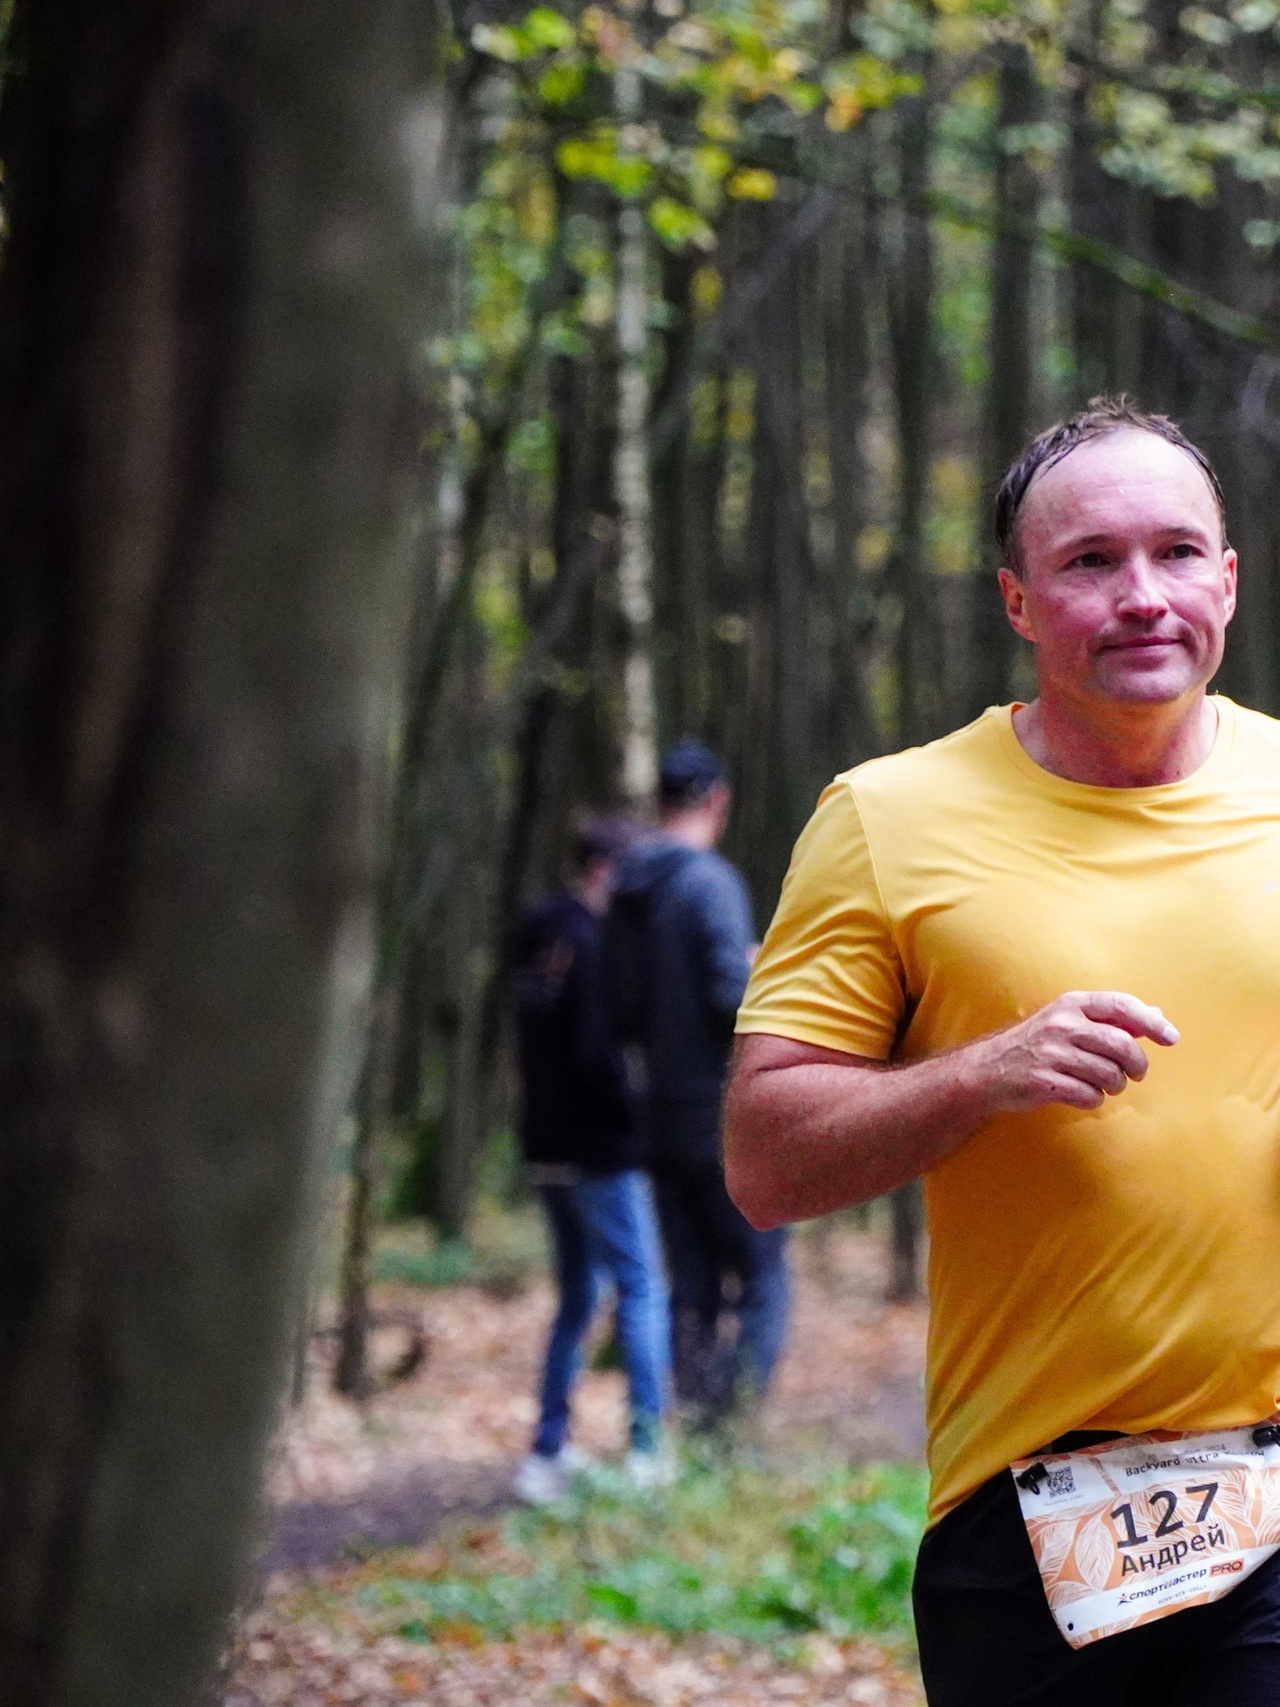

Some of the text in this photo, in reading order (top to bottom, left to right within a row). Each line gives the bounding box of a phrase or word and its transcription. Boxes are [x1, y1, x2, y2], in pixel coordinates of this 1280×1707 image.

[1125, 1457, 1181, 1477] Backyard
[1110, 1482, 1219, 1549] 127
[1121, 1523, 1225, 1577] Андрей
[1210, 1560, 1243, 1576] PRO
